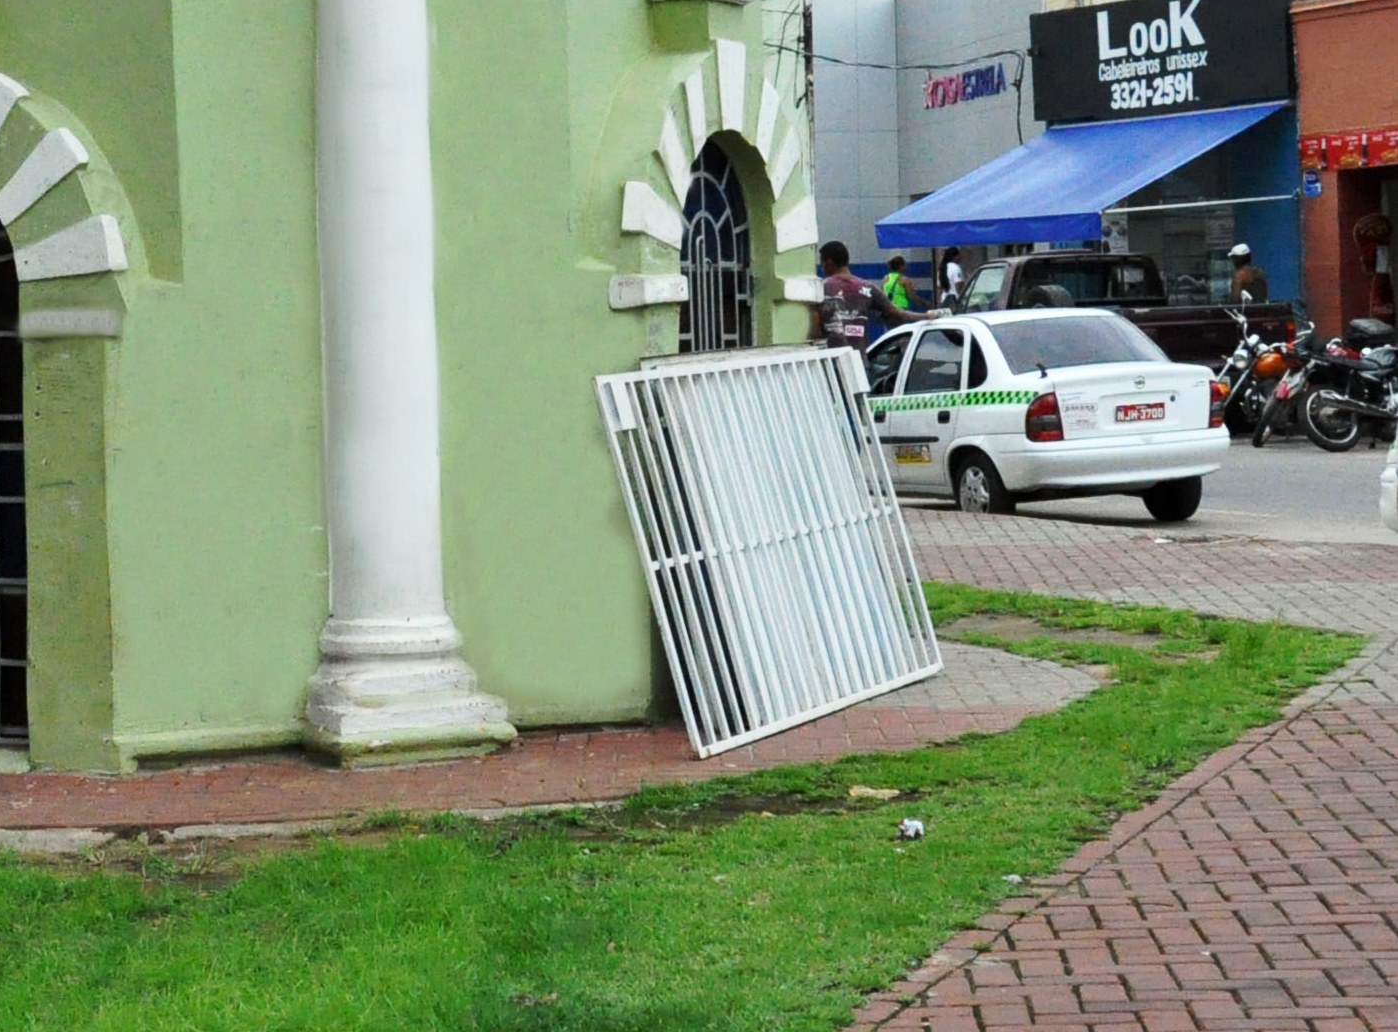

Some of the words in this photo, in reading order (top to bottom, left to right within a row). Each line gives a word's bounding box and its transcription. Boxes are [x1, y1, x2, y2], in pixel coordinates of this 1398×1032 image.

[1099, 57, 1161, 82] Cabeleireiros
[1166, 49, 1208, 71] unissex
[1110, 71, 1194, 110] 3321-2591
